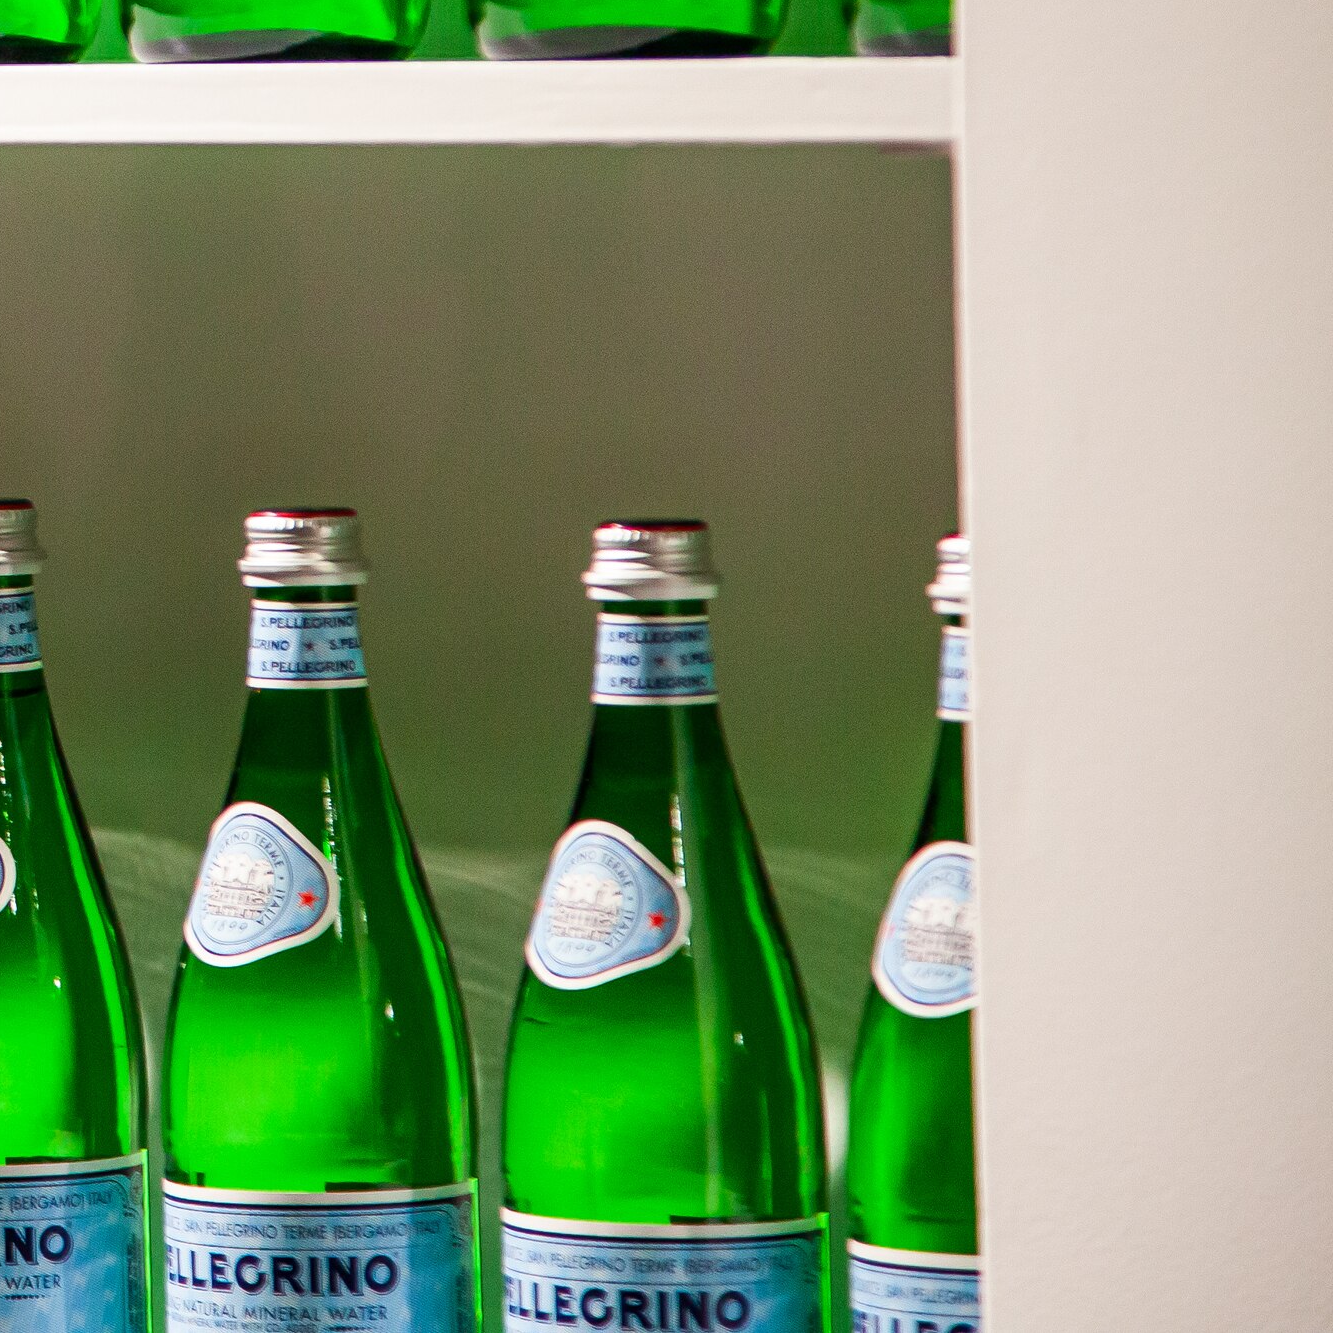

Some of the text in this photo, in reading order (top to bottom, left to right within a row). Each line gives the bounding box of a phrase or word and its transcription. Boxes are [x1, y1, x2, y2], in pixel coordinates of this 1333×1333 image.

[4, 1274, 62, 1290] WATER
[184, 1301, 388, 1322] NATURAL MINERAL WATER
